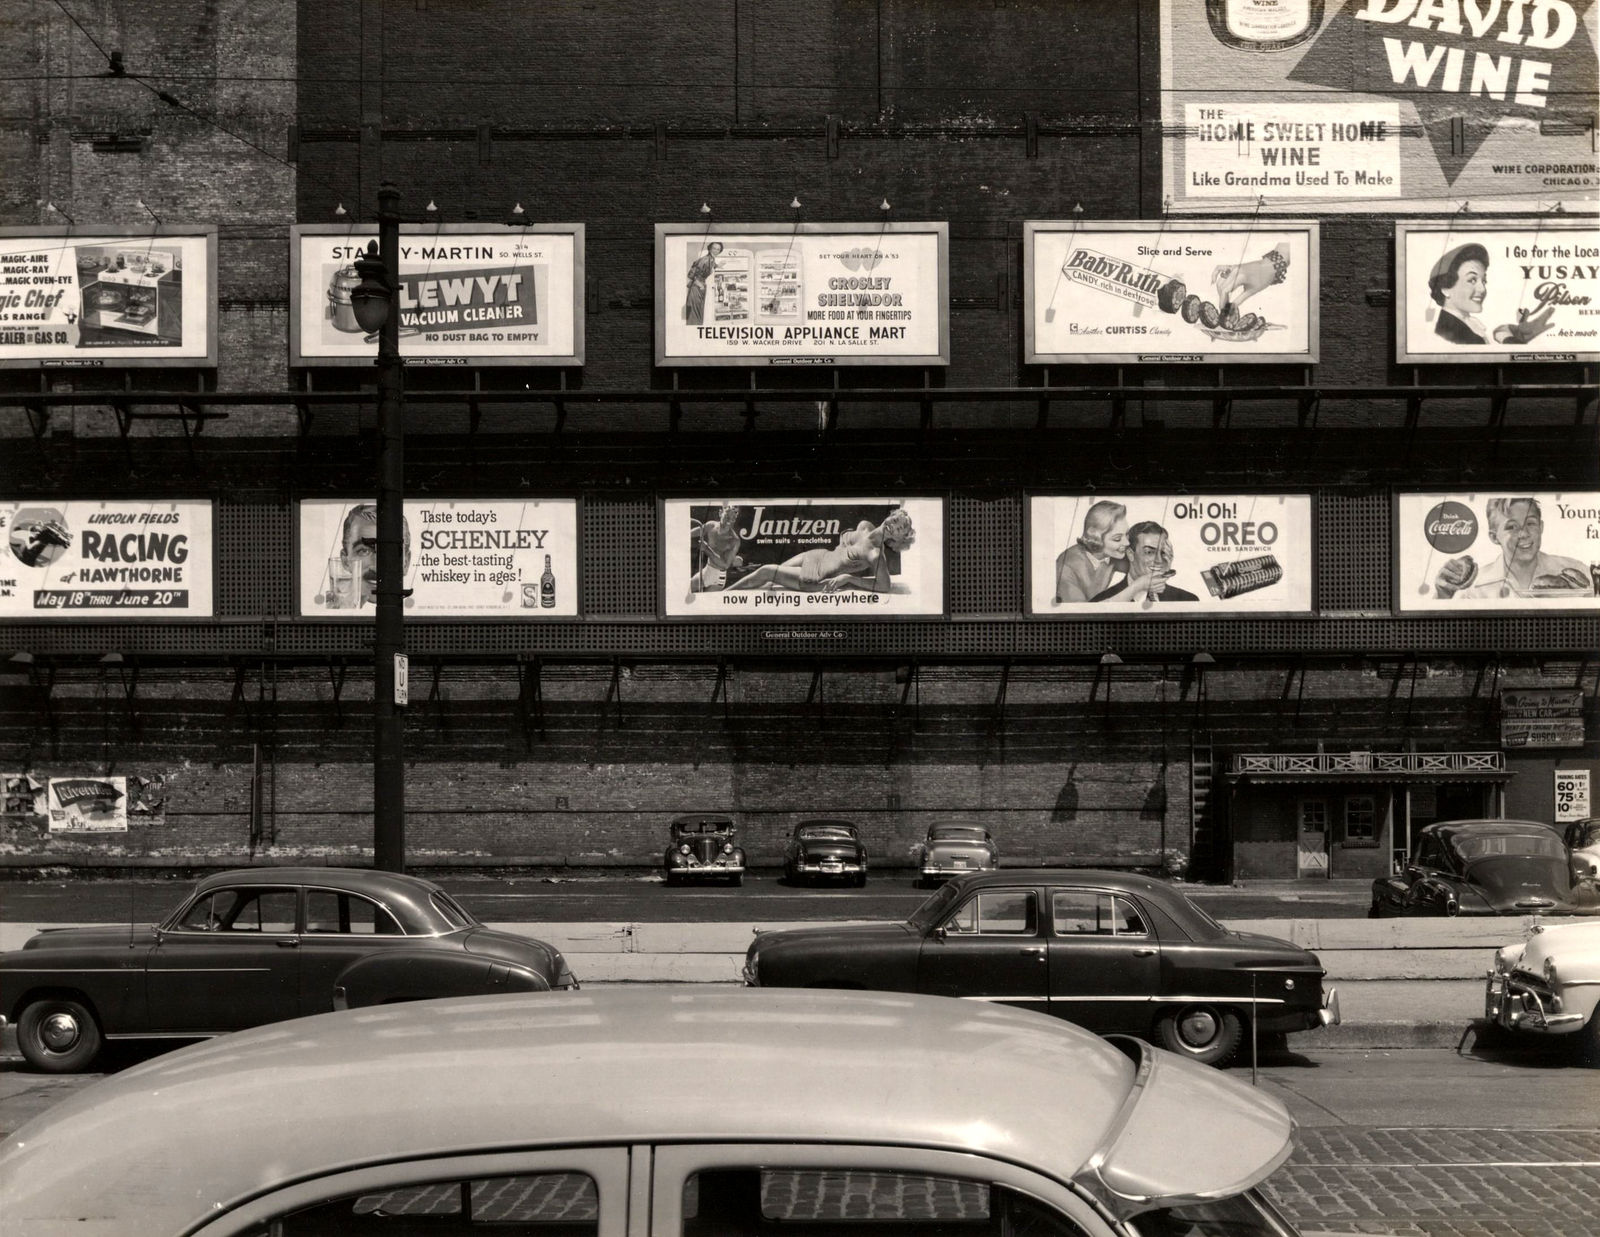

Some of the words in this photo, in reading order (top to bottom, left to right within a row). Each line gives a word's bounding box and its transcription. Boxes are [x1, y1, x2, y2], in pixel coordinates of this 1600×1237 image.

[1383, 37, 1553, 108] WINE
[1199, 109, 1224, 119] THE
[1199, 122, 1255, 142] HOME
[1263, 122, 1326, 142] SWEET
[1332, 120, 1386, 142] HOME
[1261, 147, 1320, 166] WINE
[1492, 165, 1522, 174] WINE
[1525, 164, 1595, 174] CORPORATION
[1192, 171, 1220, 186] Like
[1225, 171, 1290, 186] Grandma
[1296, 170, 1329, 186] Used
[1334, 170, 1349, 185] To
[1355, 170, 1393, 185] Make
[332, 247, 492, 260] STAY-MARTIN
[1137, 246, 1160, 256] Slice
[1163, 246, 1182, 256] and
[1185, 246, 1212, 256] Serve
[1505, 247, 1509, 258] I
[1513, 246, 1527, 258] Go
[1531, 245, 1547, 258] for
[1552, 246, 1571, 258] the
[32, 276, 73, 284] OVEN-EYE
[1520, 266, 1600, 280] YUSAY
[828, 277, 891, 290] CROSLEY
[1072, 270, 1099, 286] CANDY
[1100, 281, 1114, 292] rich
[1114, 286, 1122, 294] in
[1123, 288, 1155, 306] dextrose
[24, 289, 65, 307] Chef
[398, 274, 522, 309] LEWYT
[1527, 282, 1591, 316] Pilsen
[817, 293, 903, 307] SHELVADOR
[401, 310, 459, 326] VACUUM
[463, 305, 523, 321] CLEANER
[807, 311, 825, 320] MORE
[828, 311, 845, 320] FOOD
[847, 311, 855, 320] AT
[857, 311, 873, 320] YOUR
[875, 311, 912, 320] FINGERTIPS
[34, 332, 53, 344] GAS
[55, 332, 69, 344] CO.
[697, 327, 774, 339] TELEVISION
[784, 327, 860, 339] APPLIANCE
[869, 327, 906, 339] MART
[1575, 329, 1598, 337] made
[88, 513, 136, 525] LINCOLN
[138, 512, 180, 524] FIELDS
[420, 510, 452, 523] Taste
[456, 510, 497, 525] today's
[1173, 503, 1203, 519] Oh!
[1206, 503, 1237, 519] Oh!
[740, 506, 840, 540] Jantzen
[420, 530, 549, 549] SCHENLEY
[1200, 521, 1278, 546] OREO
[81, 530, 188, 565] RACING
[443, 554, 513, 570] best-tasting
[60, 571, 78, 584] at
[80, 567, 183, 584] HAWTHORNE
[421, 569, 470, 585] whiskey
[474, 569, 485, 582] in
[488, 569, 522, 585] ages!
[37, 592, 68, 609] May
[89, 595, 112, 605] THRU
[115, 593, 149, 605] June
[723, 595, 748, 605] now
[755, 593, 800, 607] playing
[807, 592, 879, 607] everywhere
[1523, 709, 1537, 717] NEW
[1539, 708, 1552, 717] CAR
[1531, 732, 1556, 742] SUSCO
